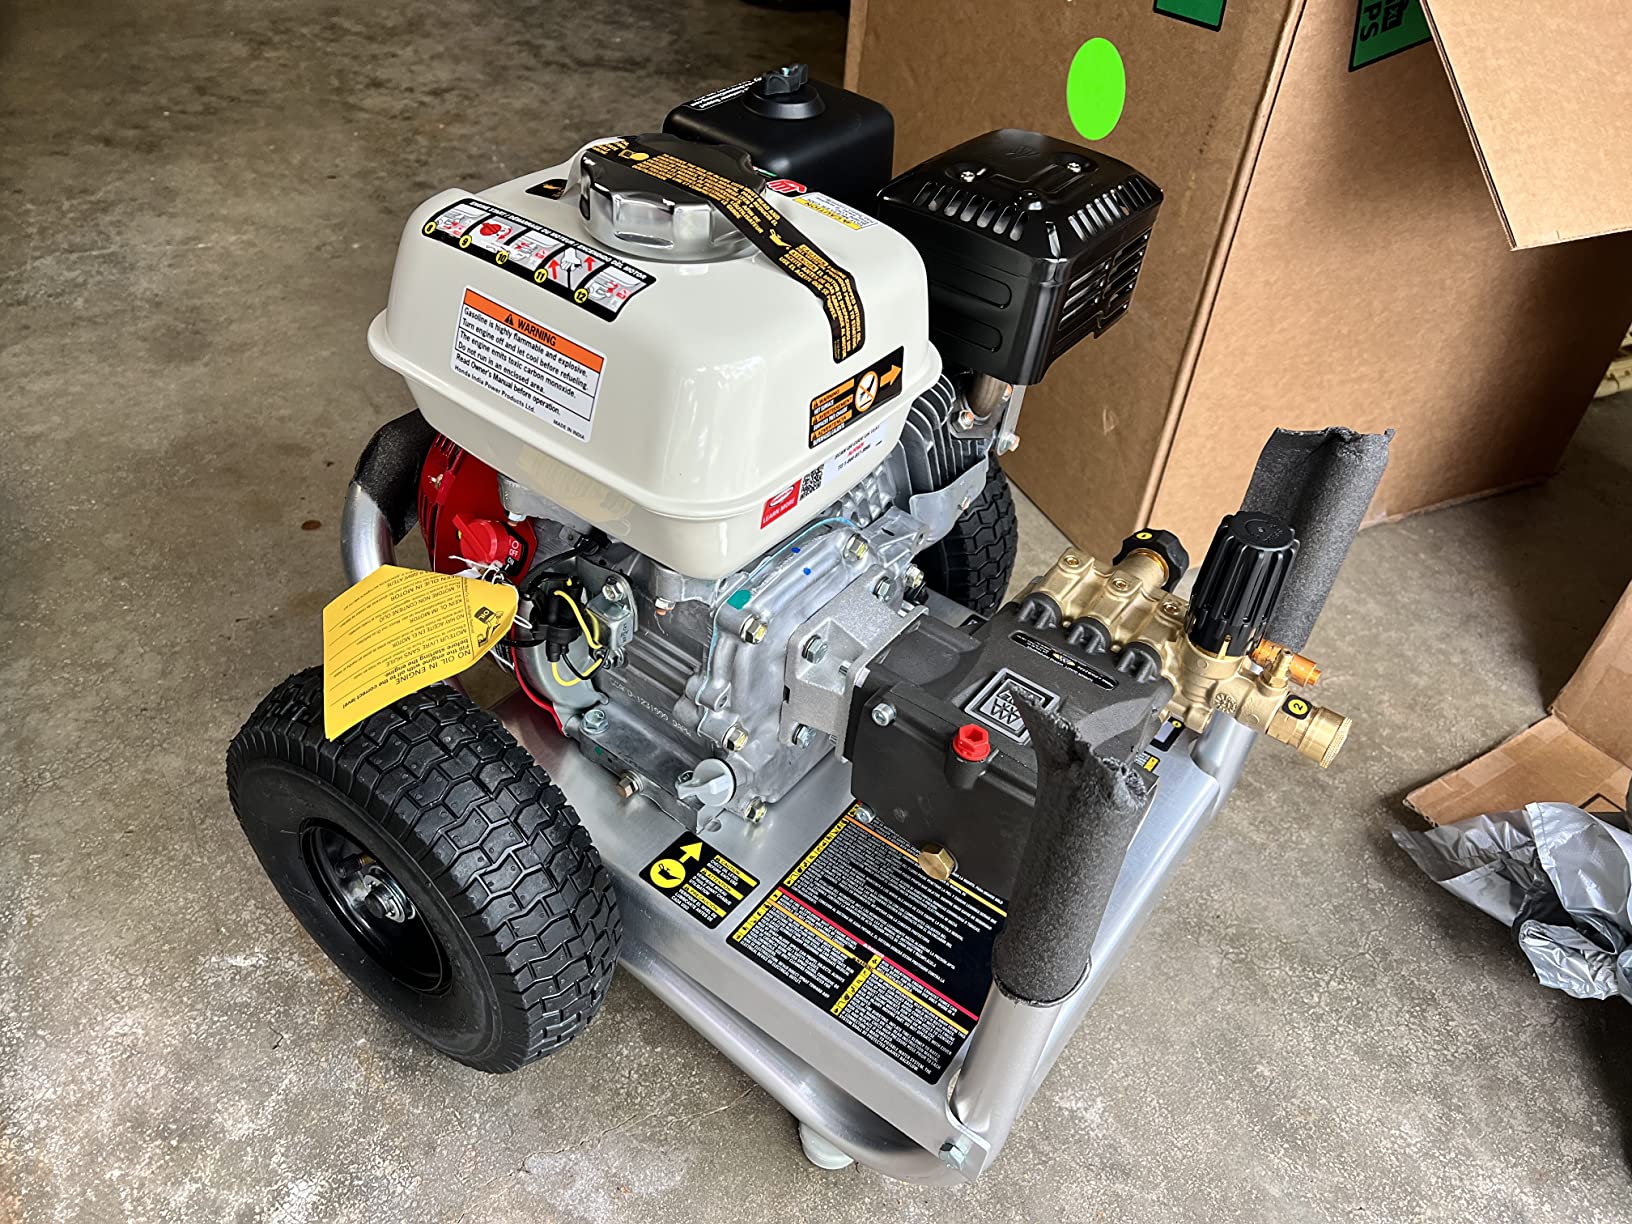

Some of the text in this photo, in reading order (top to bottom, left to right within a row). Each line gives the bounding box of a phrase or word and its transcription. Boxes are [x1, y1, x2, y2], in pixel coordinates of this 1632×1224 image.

[623, 266, 647, 279] MOTOR
[517, 319, 556, 346] WARNING
[464, 307, 588, 377] Gasoline is highly flammable and explosive.
[462, 318, 474, 330] Turn
[475, 325, 494, 341] engine
[504, 340, 515, 351] and
[526, 351, 538, 363] cool
[540, 359, 559, 374] before
[560, 370, 588, 391] refueling.
[458, 341, 545, 393] Do not run in an enclosed area.
[460, 331, 576, 398] The engine emits toxic carbon monoxide.
[454, 365, 535, 413] Honda India Power Products Ltd.
[456, 353, 560, 416] Read Owner's Manual before operation.
[761, 508, 779, 522] LEARN
[509, 548, 518, 556] OFF
[391, 587, 414, 602] MOTOR
[409, 611, 429, 622] MOTOR
[478, 610, 490, 620] OIL
[386, 628, 465, 666] MOTEUR LIVRE SANS HUILE
[391, 636, 409, 648] MOTOR
[447, 638, 467, 650] before
[419, 646, 444, 661] starting
[422, 652, 444, 665] engine
[395, 648, 470, 684] NO OIL IN ENGINE
[407, 663, 419, 672] with
[378, 678, 387, 686] the
[357, 684, 376, 698] correct
[342, 697, 354, 708] level
[721, 860, 740, 874] CAUTION
[708, 874, 730, 891] ATTENTION
